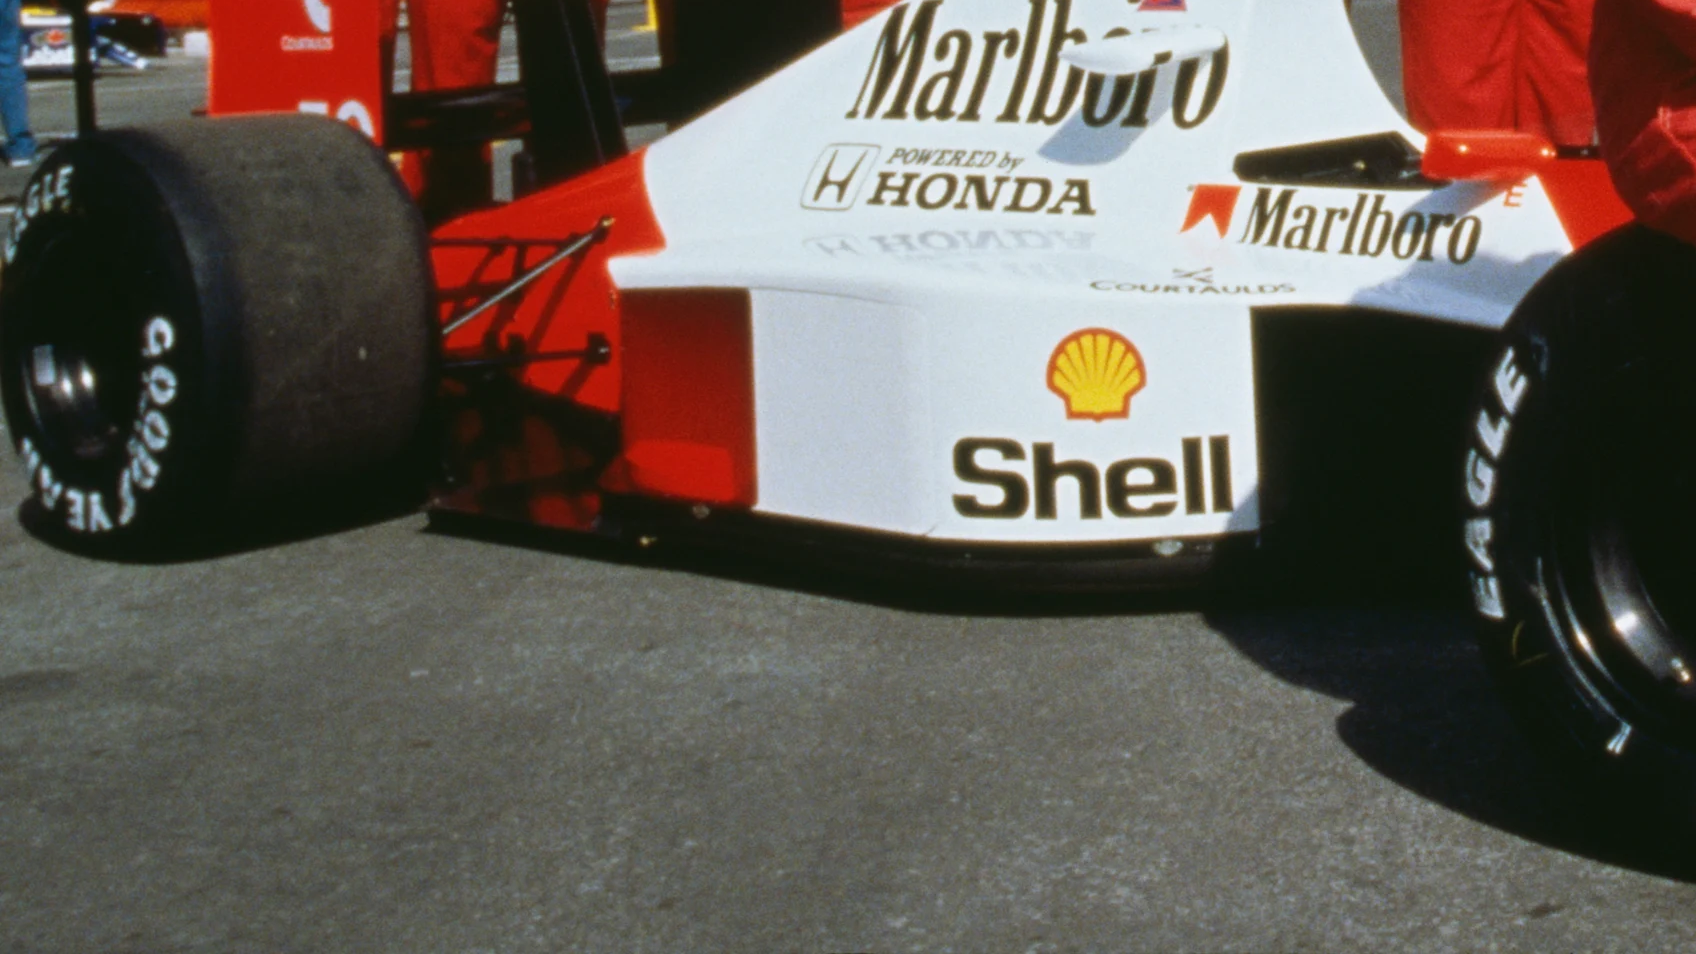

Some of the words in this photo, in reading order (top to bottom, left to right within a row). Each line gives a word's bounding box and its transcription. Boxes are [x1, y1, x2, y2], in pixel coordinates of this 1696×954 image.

[886, 147, 998, 168] POWERED
[999, 155, 1025, 175] by
[866, 172, 1097, 217] HONDA
[1237, 185, 1482, 265] Marlboro
[1090, 279, 1297, 295] COURTAULDS
[952, 434, 1234, 521] Shell
[1464, 346, 1529, 620] EAGLE
